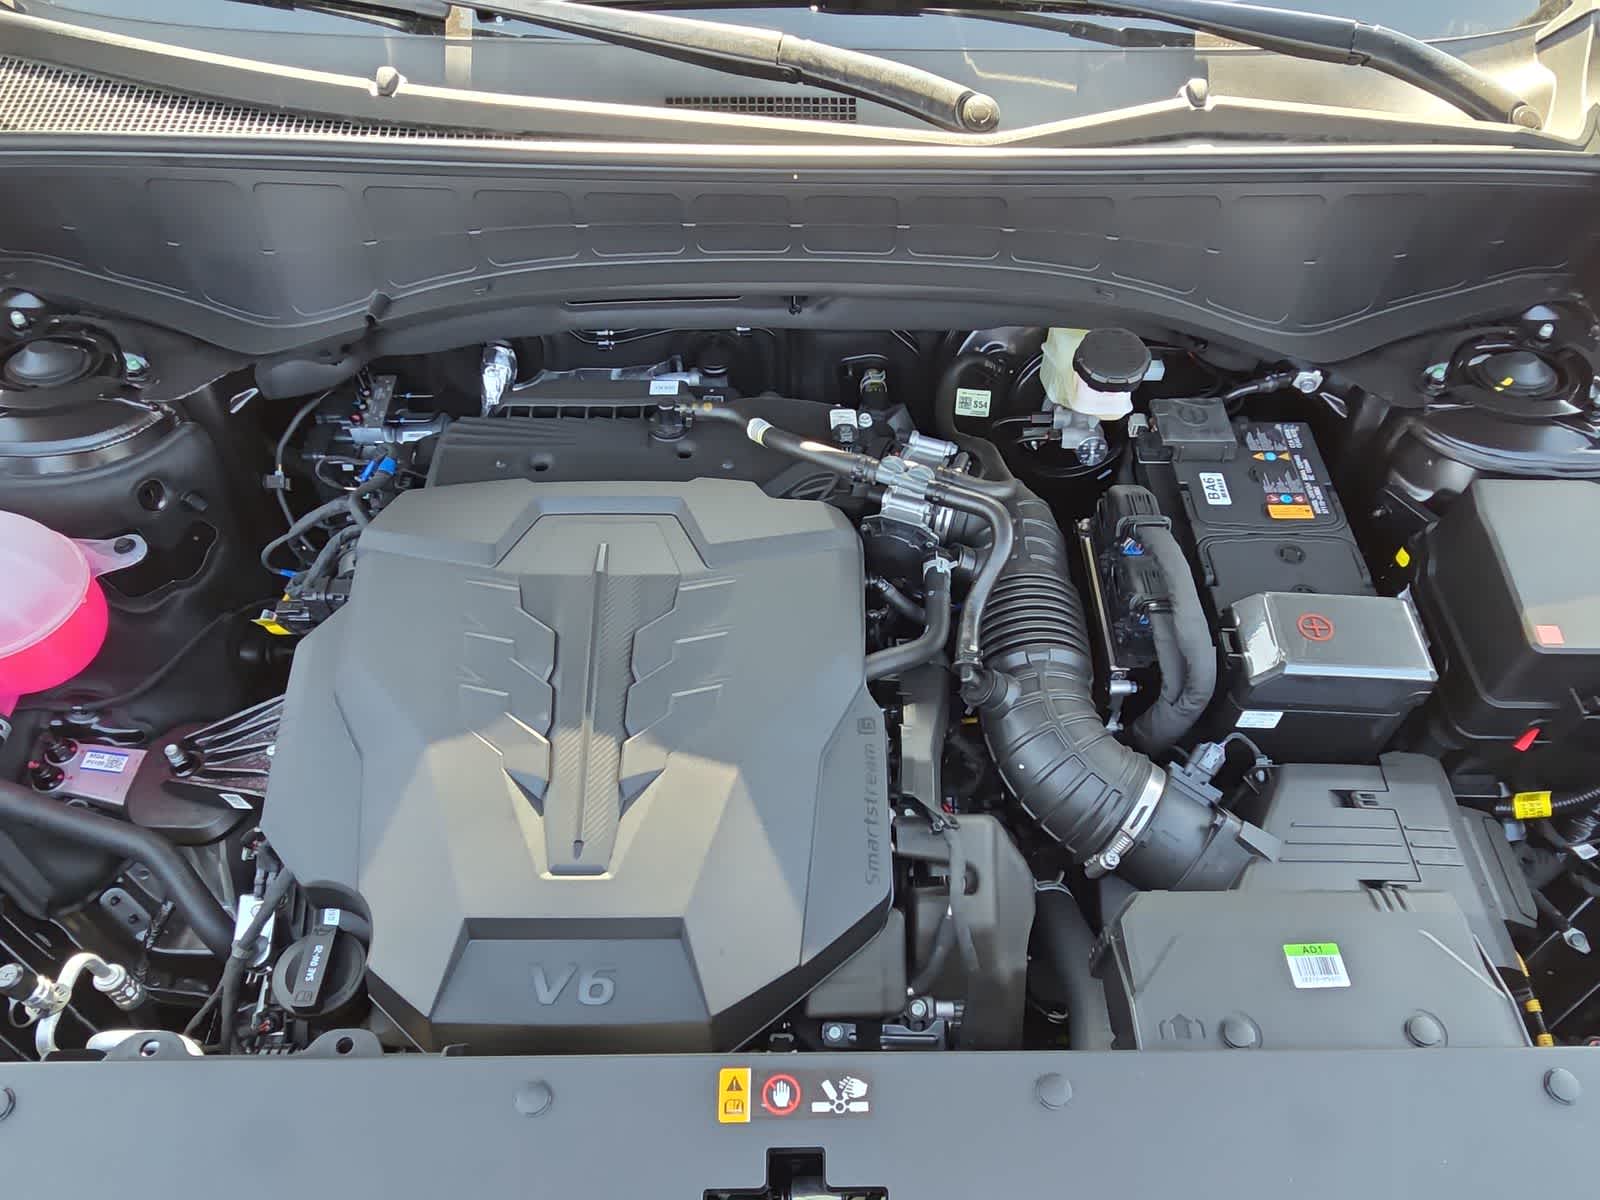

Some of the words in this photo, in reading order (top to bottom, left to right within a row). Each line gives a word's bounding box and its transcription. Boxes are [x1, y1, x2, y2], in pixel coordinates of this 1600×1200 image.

[1203, 477, 1220, 500] BA6
[864, 743, 880, 886] Smartstream
[305, 967, 316, 982] SAE
[529, 961, 617, 1006] V6
